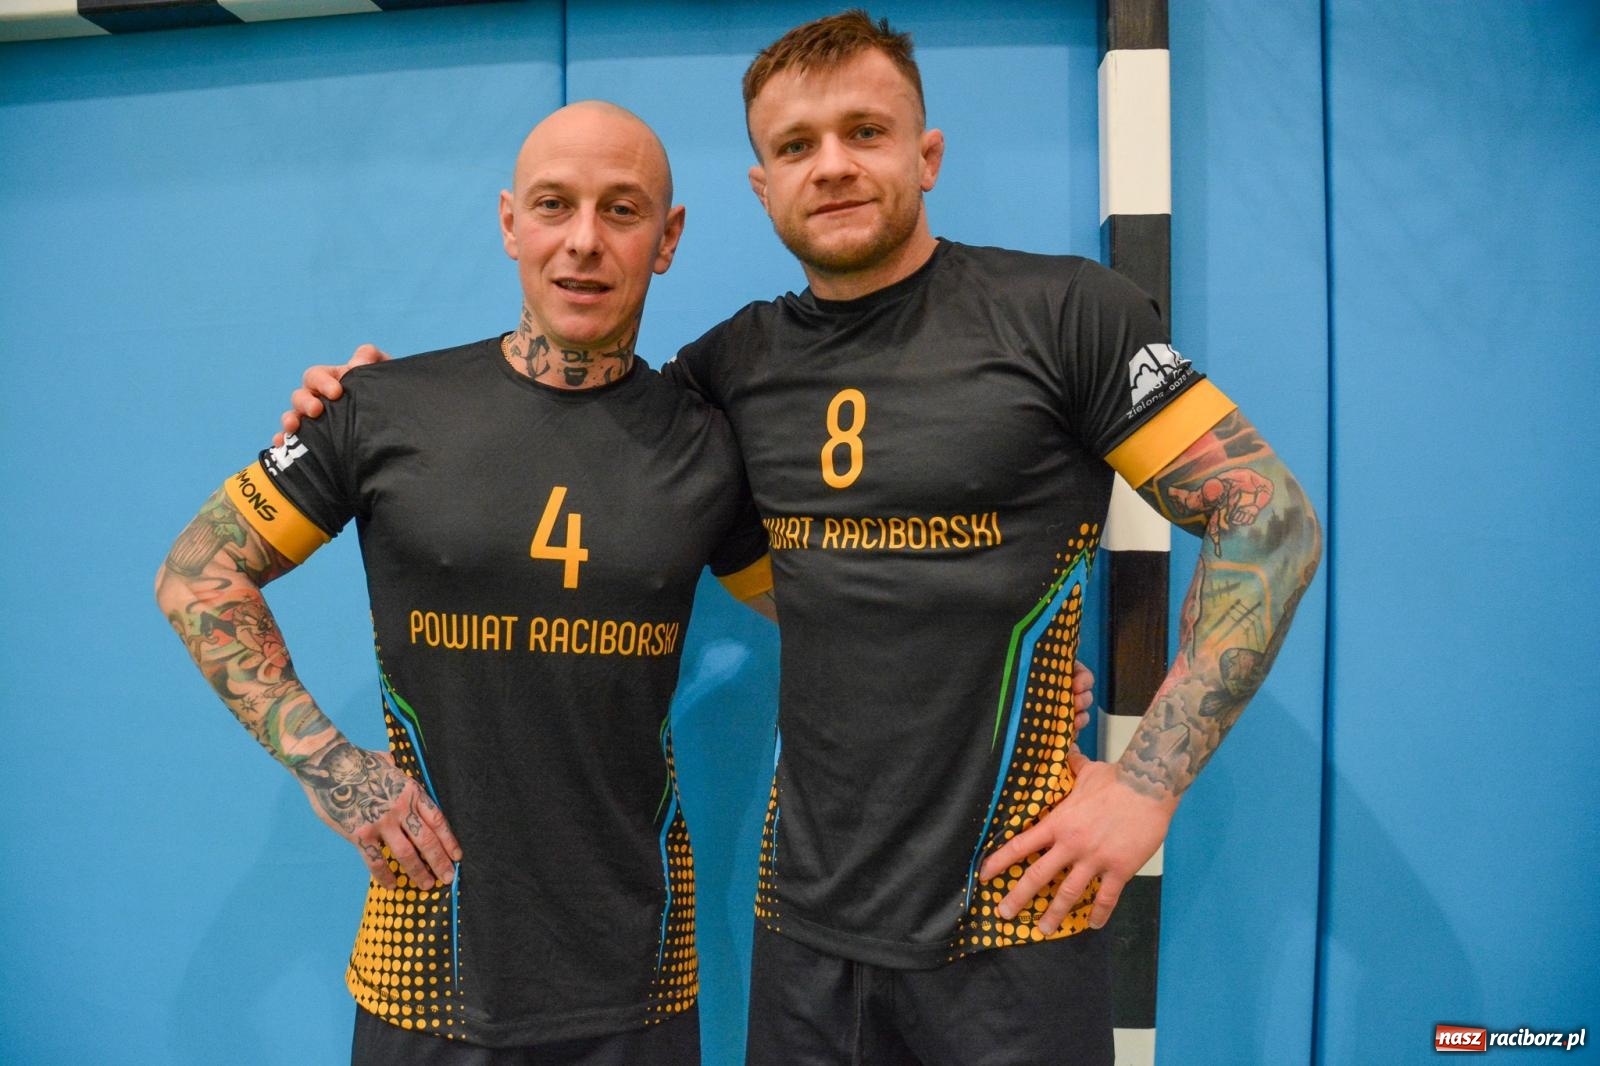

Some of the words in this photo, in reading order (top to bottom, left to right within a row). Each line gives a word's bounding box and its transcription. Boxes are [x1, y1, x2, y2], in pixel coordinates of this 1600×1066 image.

[821, 388, 866, 489] 8
[530, 486, 589, 589] 4
[822, 511, 1002, 549] RACIBORSKI
[410, 610, 518, 651] POWIAT
[529, 616, 679, 656] RACIBORSKI
